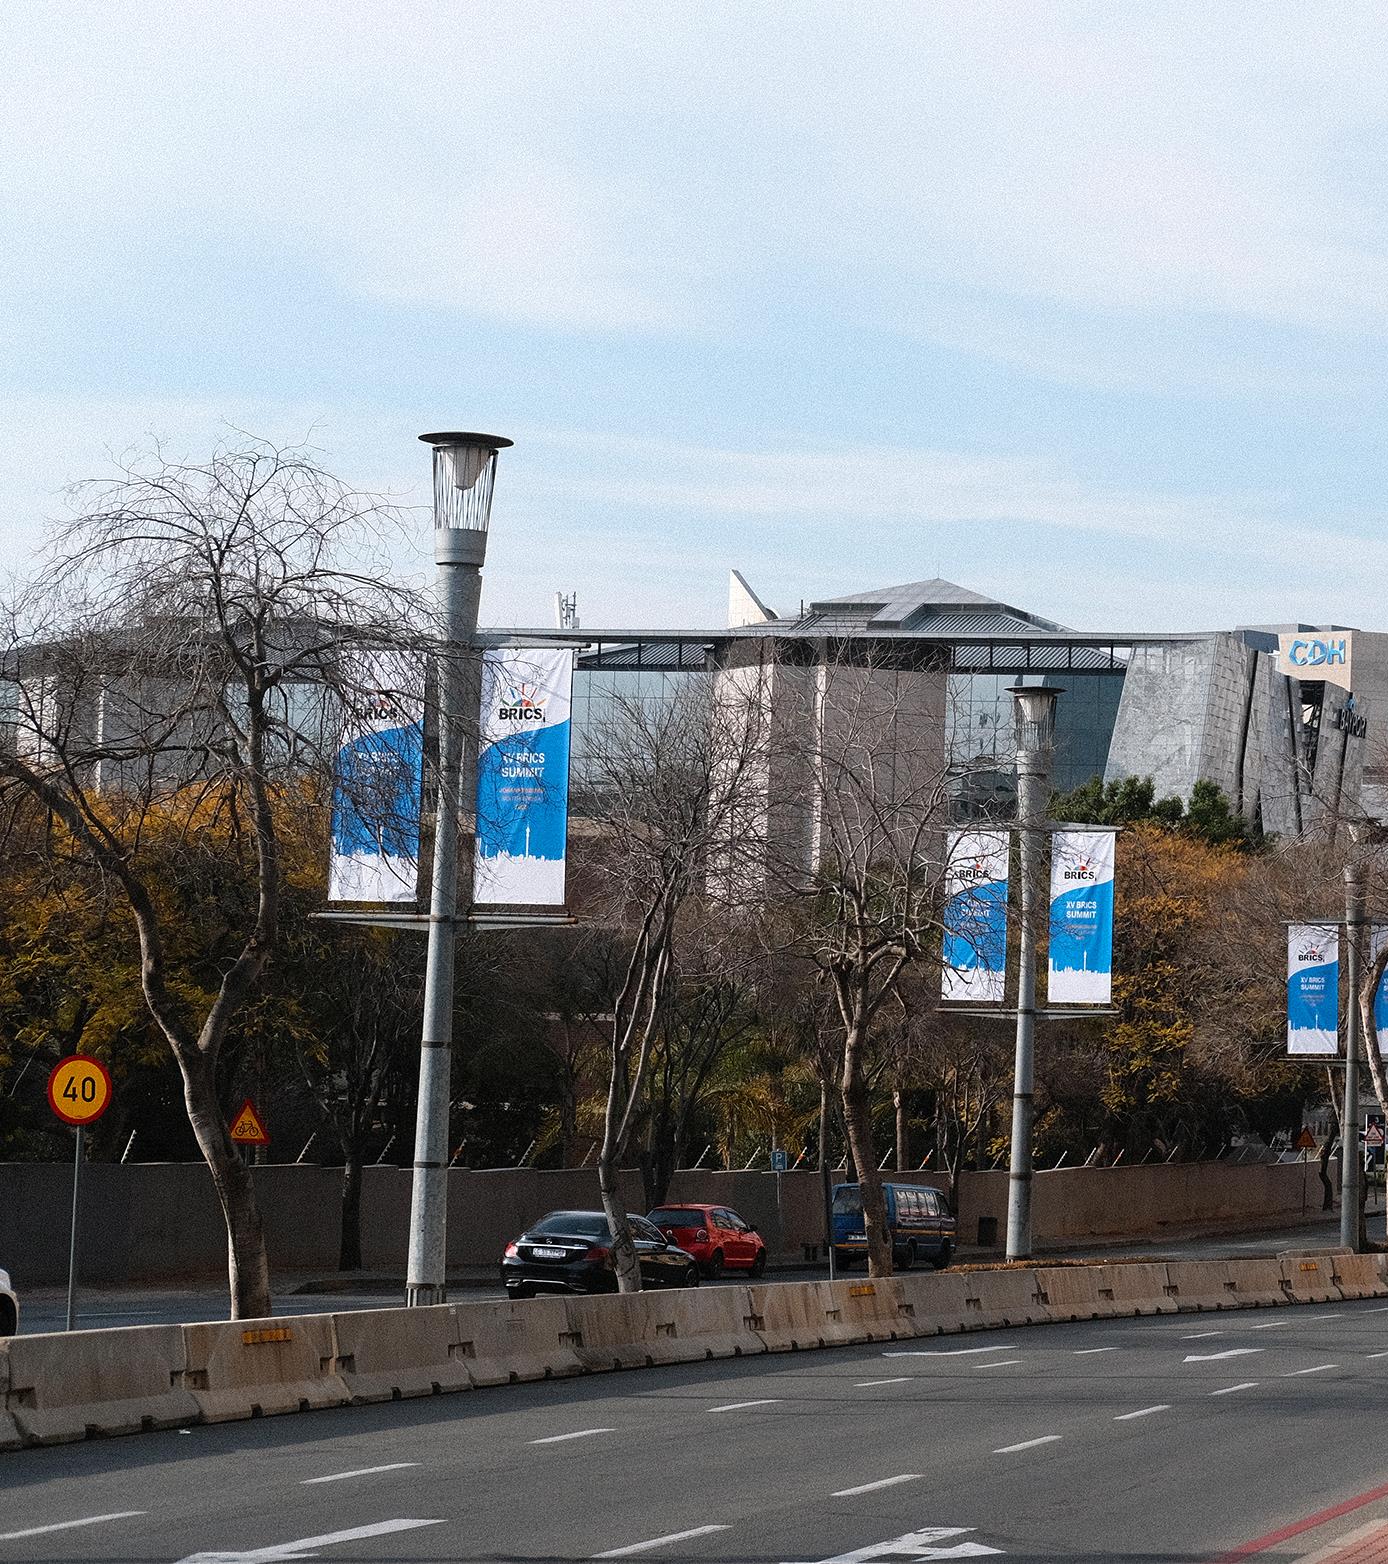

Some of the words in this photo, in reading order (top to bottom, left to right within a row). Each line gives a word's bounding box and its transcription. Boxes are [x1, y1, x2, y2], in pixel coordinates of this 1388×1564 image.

[1289, 639, 1346, 666] CDH
[499, 708, 542, 720] BRICS
[516, 753, 545, 763] BRICS
[501, 767, 545, 778] SUMMIT
[959, 869, 990, 878] BRICS
[1064, 871, 1095, 880] BRICS
[1066, 901, 1075, 909] XV
[1076, 901, 1097, 909] BRICS
[1066, 910, 1097, 918] SUMMIT
[62, 1076, 96, 1103] 40
